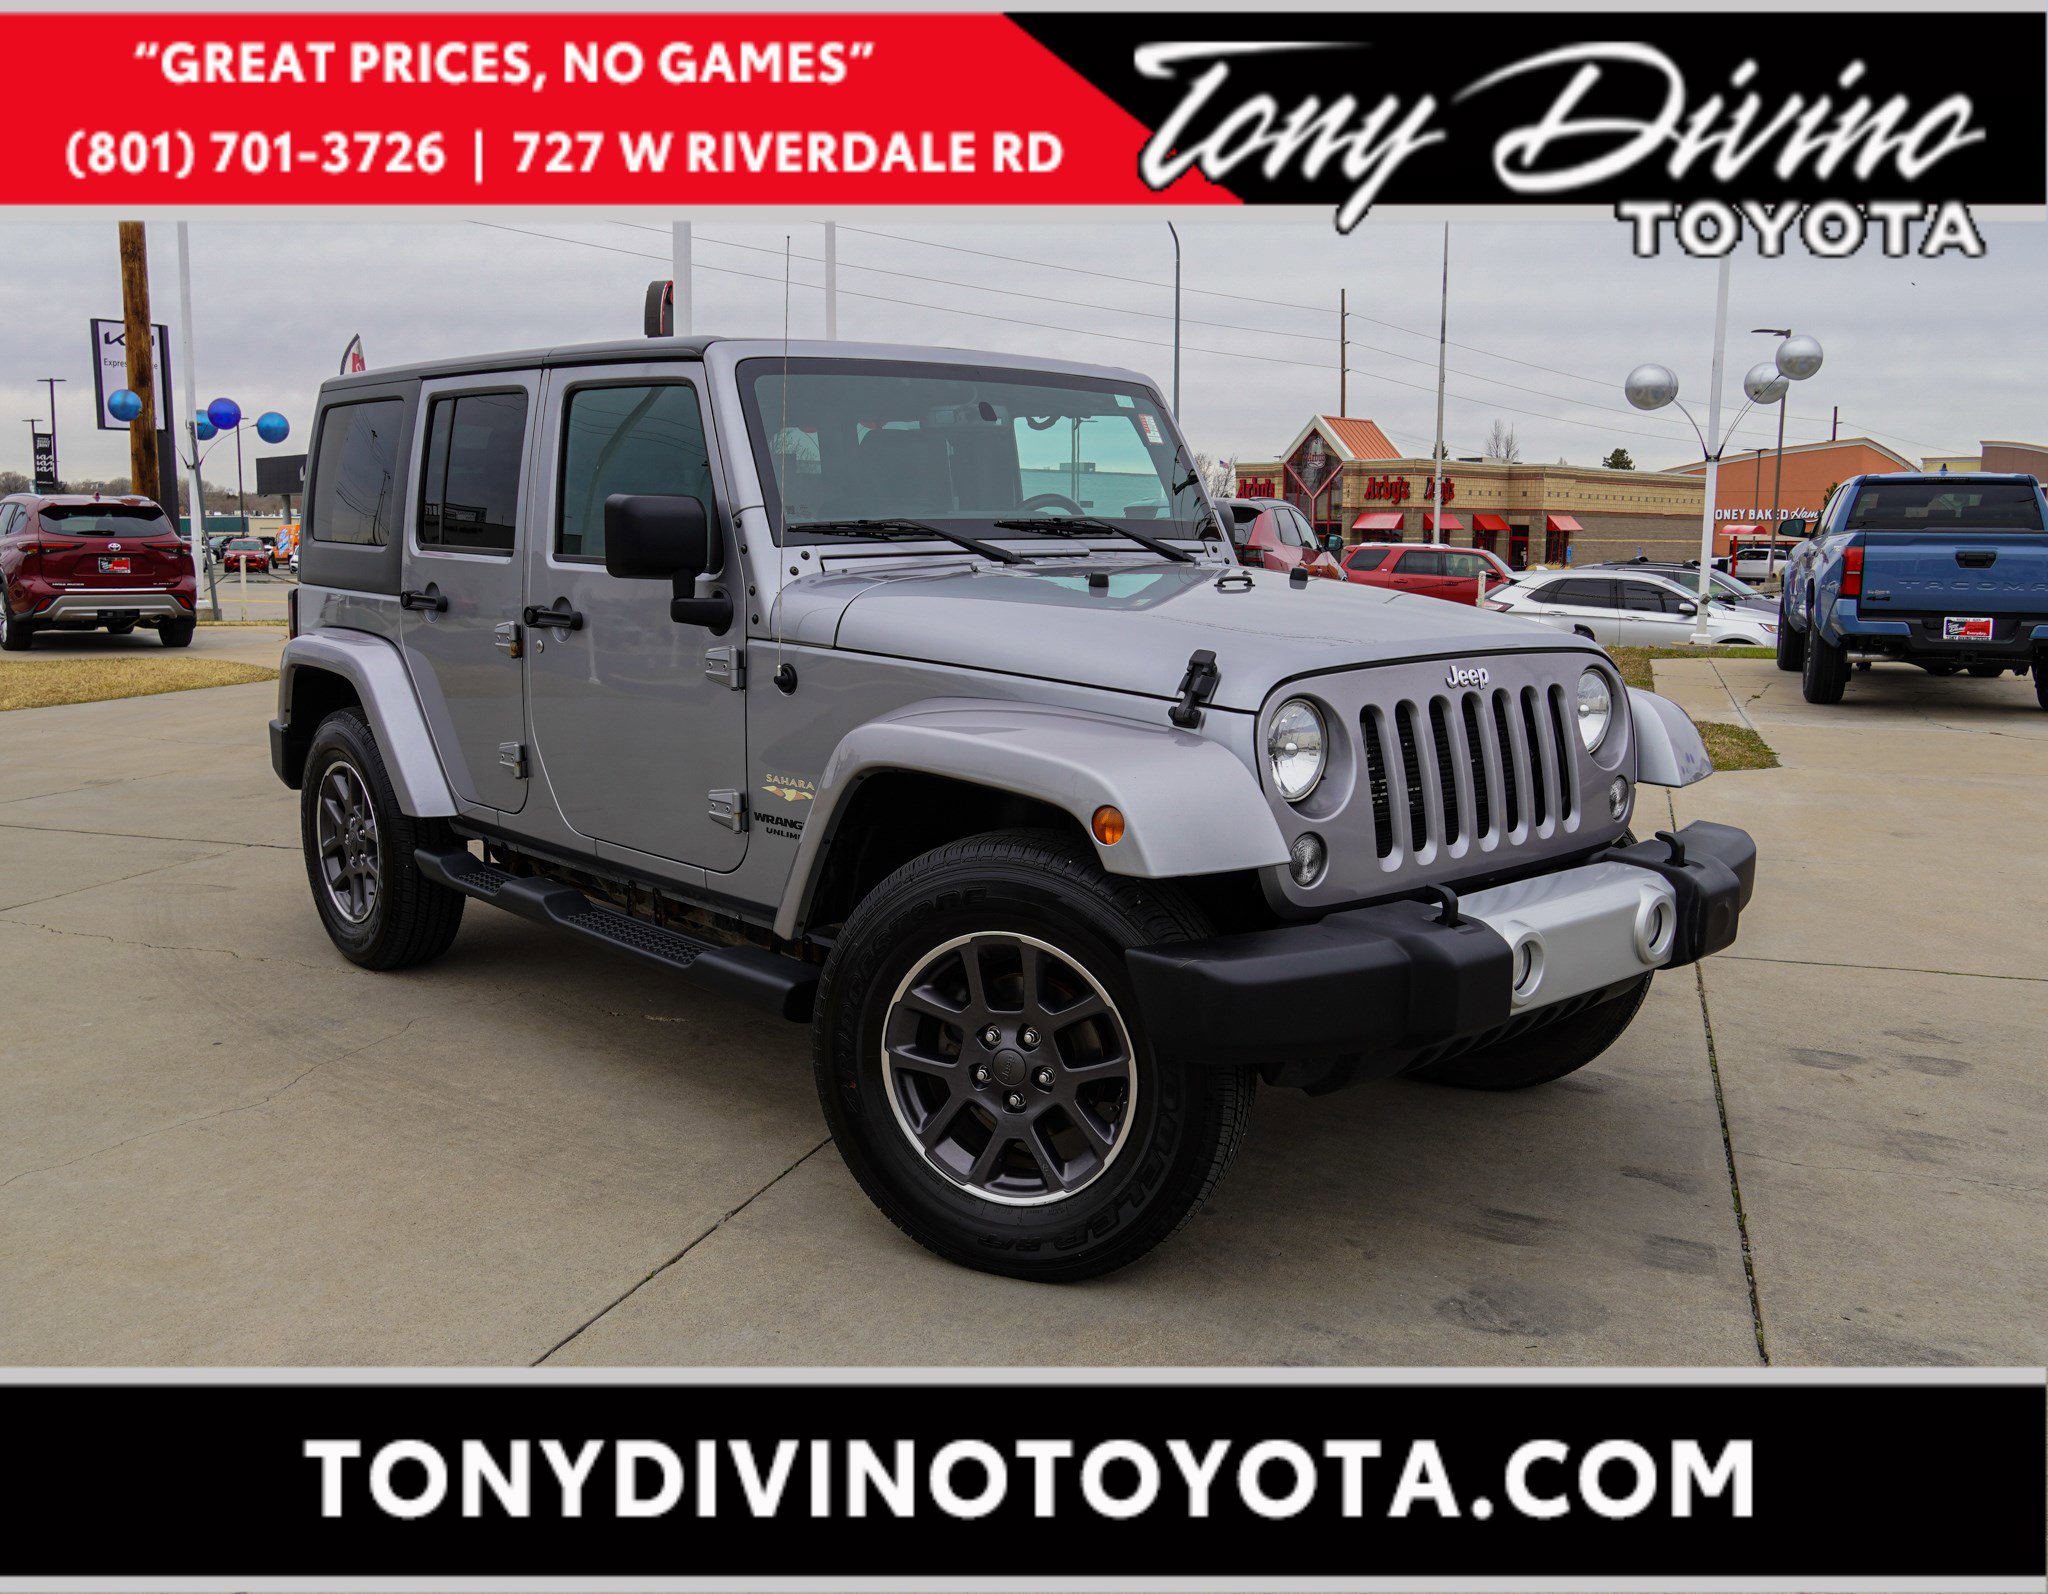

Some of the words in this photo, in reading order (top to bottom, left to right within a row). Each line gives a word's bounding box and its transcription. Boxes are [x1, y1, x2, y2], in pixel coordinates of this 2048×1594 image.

[103, 358, 128, 369] Expres
[1364, 475, 1410, 505] Arby's
[1715, 508, 1746, 520] ONEY
[1445, 665, 1489, 690] Jeep
[765, 773, 815, 791] SAHARA
[753, 811, 805, 831] WRANG
